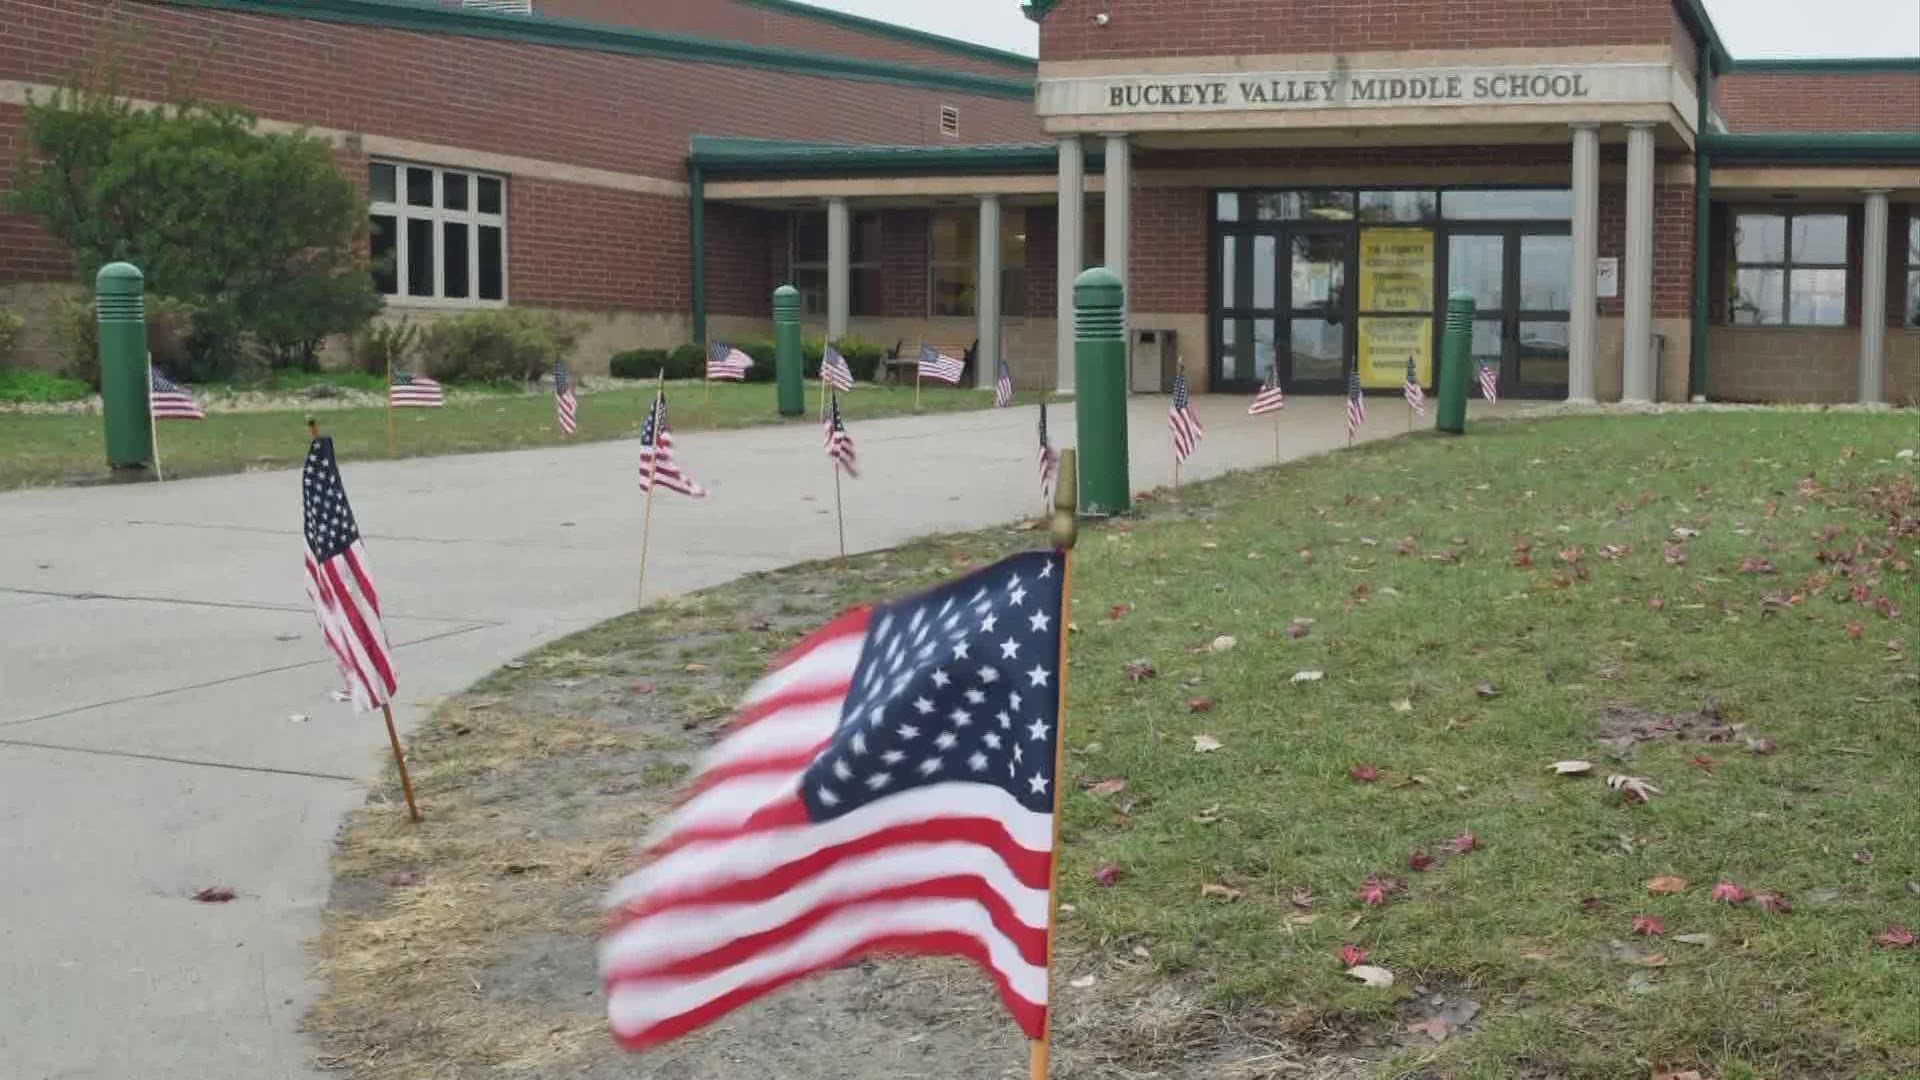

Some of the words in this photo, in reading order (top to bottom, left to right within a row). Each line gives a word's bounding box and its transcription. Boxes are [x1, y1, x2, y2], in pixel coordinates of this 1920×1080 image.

[1109, 83, 1227, 107] BUCKEYE
[1239, 80, 1337, 103] VALLEY
[1350, 76, 1463, 101] MIDDLE
[1473, 73, 1588, 98] SCHOOL
